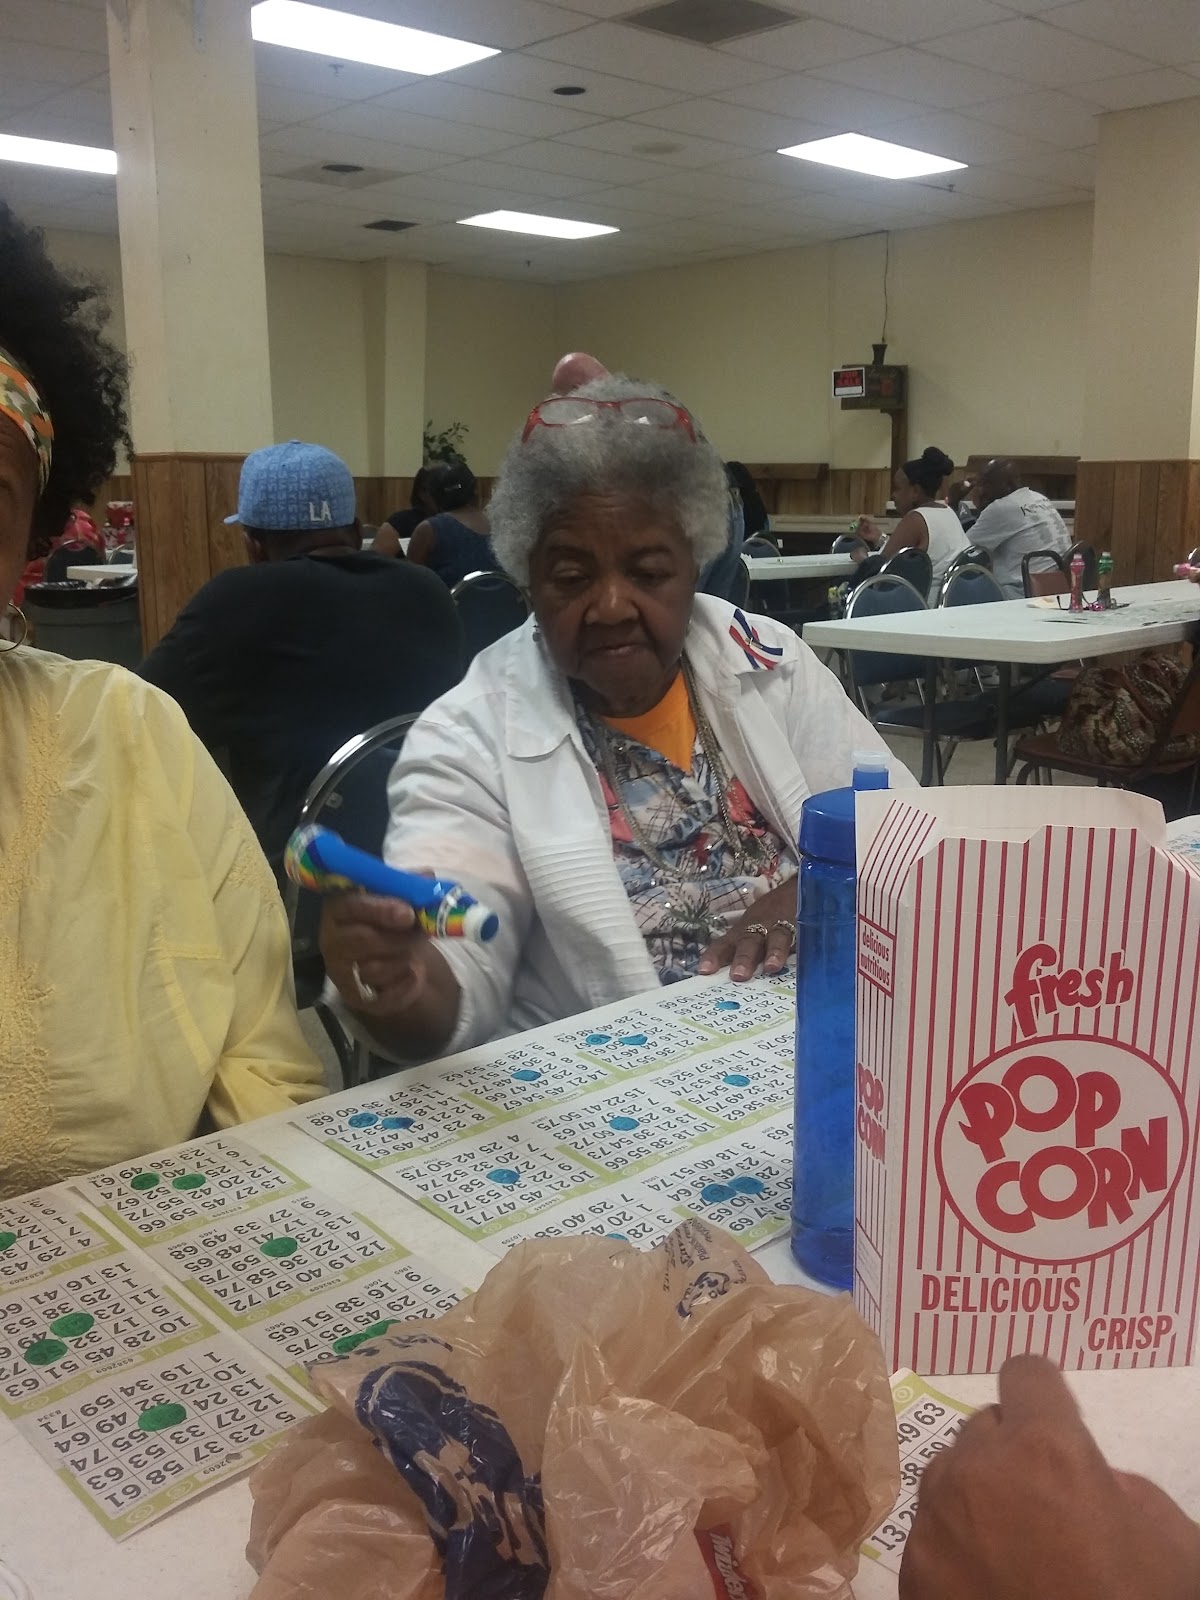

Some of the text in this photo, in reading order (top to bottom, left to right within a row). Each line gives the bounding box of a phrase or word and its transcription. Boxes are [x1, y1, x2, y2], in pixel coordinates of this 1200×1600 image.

[309, 500, 332, 521] LA
[863, 924, 890, 962] delicious
[860, 953, 890, 987] nutritious
[1004, 943, 1135, 1037] fresh
[858, 1062, 884, 1117] POP
[958, 1056, 1121, 1163] POP
[857, 1103, 887, 1165] CORN
[604, 1121, 715, 1170] 10 18 38 55 66
[647, 1142, 756, 1191] 3 18 40 51 74
[712, 1167, 735, 1180] 45
[735, 1156, 760, 1170] 23
[689, 1175, 715, 1189] 59
[975, 1115, 1168, 1234] CORN
[29, 1200, 43, 1208] 3
[137, 1175, 286, 1233] 13 27 45 59 66
[300, 1200, 315, 1209] 9
[465, 1170, 594, 1225] 10 21 45 47 71
[666, 1188, 692, 1202] 64
[269, 1208, 293, 1223] 27
[315, 1209, 332, 1218] 5
[561, 1193, 634, 1228] 7 29 40
[606, 1203, 653, 1226] 1 20
[1, 1215, 31, 1228] 21
[15, 1216, 67, 1239] 1 27
[233, 1221, 261, 1235] 33
[284, 1218, 307, 1233] 17
[626, 1214, 673, 1239] 3 28
[28, 1226, 82, 1251] 7 17
[201, 1233, 227, 1248] 49
[0, 1238, 91, 1276] 4 29 43
[169, 1245, 198, 1260] 68
[198, 1215, 352, 1285] 13 23 59 75
[215, 1244, 242, 1259] 48
[100, 1262, 131, 1278] 13
[183, 1257, 213, 1272] 65
[213, 1230, 360, 1298] 4 22 36 58 74
[66, 1274, 97, 1291] 16
[228, 1240, 385, 1311] 12 19 40 57 72
[29, 1289, 58, 1305] 41
[129, 1288, 160, 1305] 11
[921, 1273, 1081, 1313] DELICIOUS
[2, 1277, 138, 1335] 1 25 38 53
[93, 1302, 126, 1320] 23
[151, 1305, 170, 1317] 5
[267, 1271, 421, 1342] 9 16 38 51 65
[113, 1316, 140, 1334] 17
[159, 1315, 191, 1333] 10
[285, 1283, 441, 1356] 5 29 45 55 75
[68, 1330, 103, 1349] 32
[122, 1329, 156, 1348] 28
[1087, 1313, 1173, 1352] CRISP
[84, 1346, 115, 1363] 45
[44, 1360, 80, 1379] 51
[213, 1362, 246, 1381] 10
[4, 1378, 39, 1397] 63
[39, 1351, 222, 1434] 1 19 34 59 71
[174, 1377, 210, 1395] 22
[69, 1377, 264, 1472] 13 24 55 74
[95, 1411, 127, 1433] 49
[275, 1411, 296, 1423] 5
[913, 1402, 946, 1426] 63
[54, 1431, 90, 1453] 64
[86, 1393, 283, 1490] 12 27 33 53 63
[228, 1423, 265, 1443] 23
[193, 1441, 224, 1462] 37
[145, 1459, 184, 1484] 58
[104, 1484, 141, 1507] 61
[871, 1524, 907, 1551] 13
